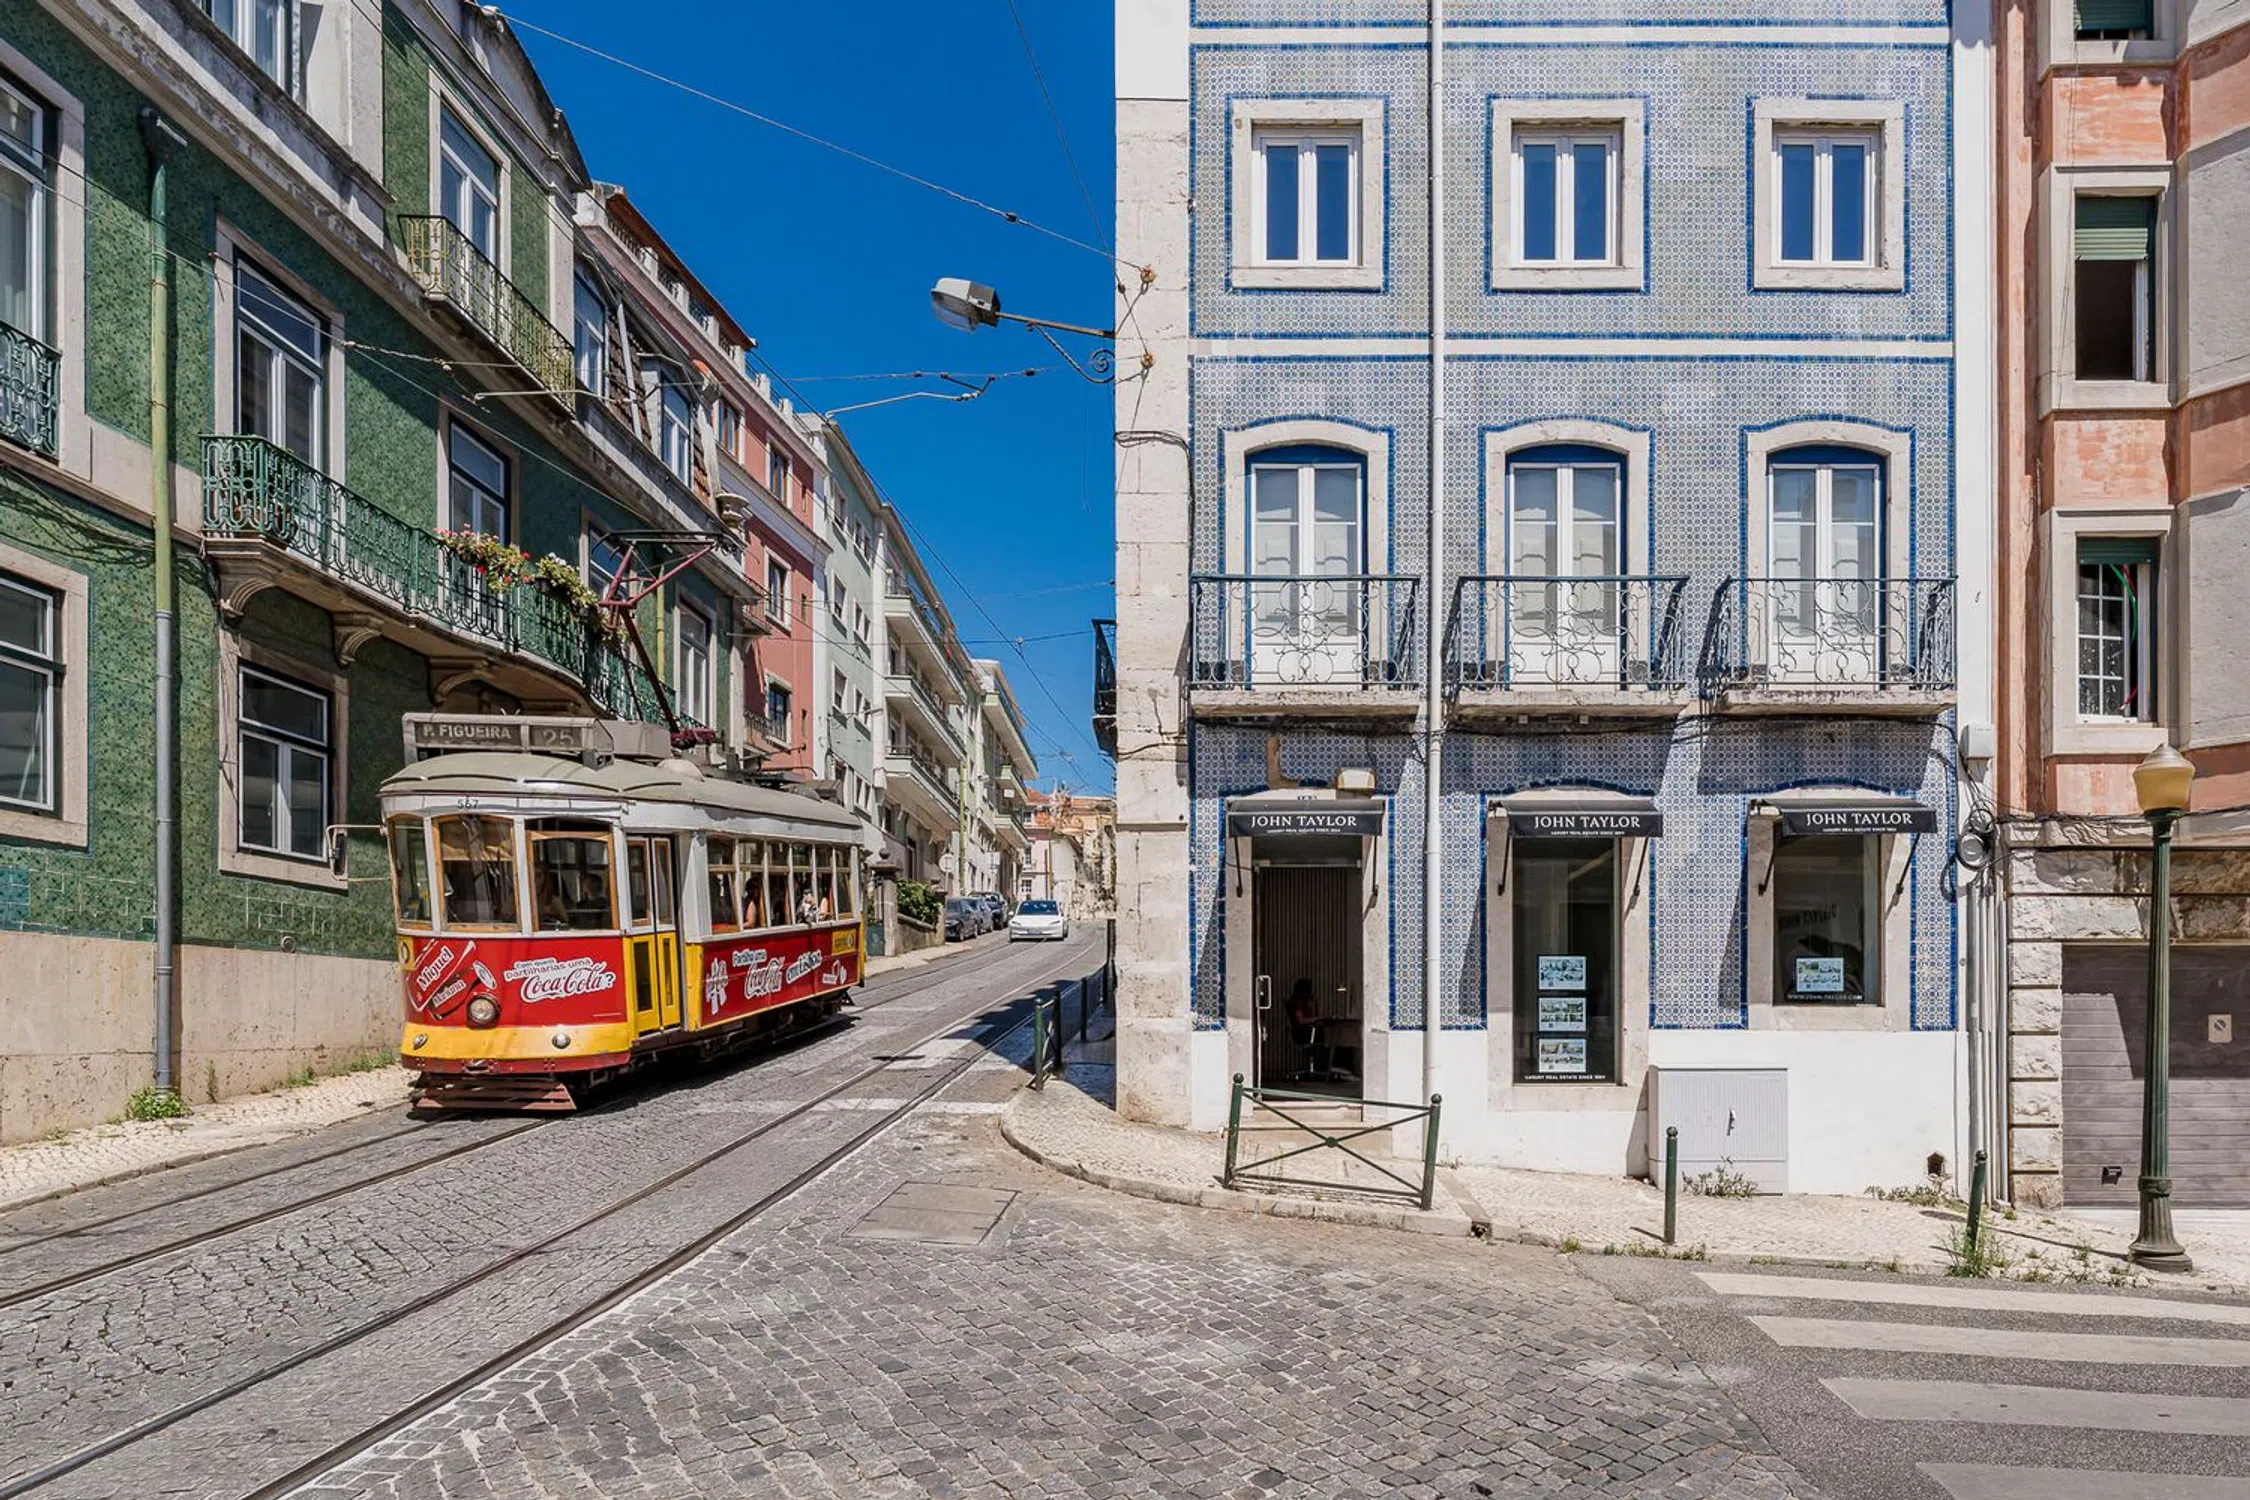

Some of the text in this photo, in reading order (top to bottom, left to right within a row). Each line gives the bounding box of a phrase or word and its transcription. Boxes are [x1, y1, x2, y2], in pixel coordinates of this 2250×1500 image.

[423, 724, 513, 740] P. FIGUEIRA
[542, 728, 575, 747] 25
[457, 799, 479, 810] 567
[1251, 815, 1357, 828] JOHN TAYLOR
[1534, 816, 1641, 829] JOHN TAYLOR
[1806, 812, 1913, 827] JOHN TAYLOR
[417, 947, 453, 990] Miguel
